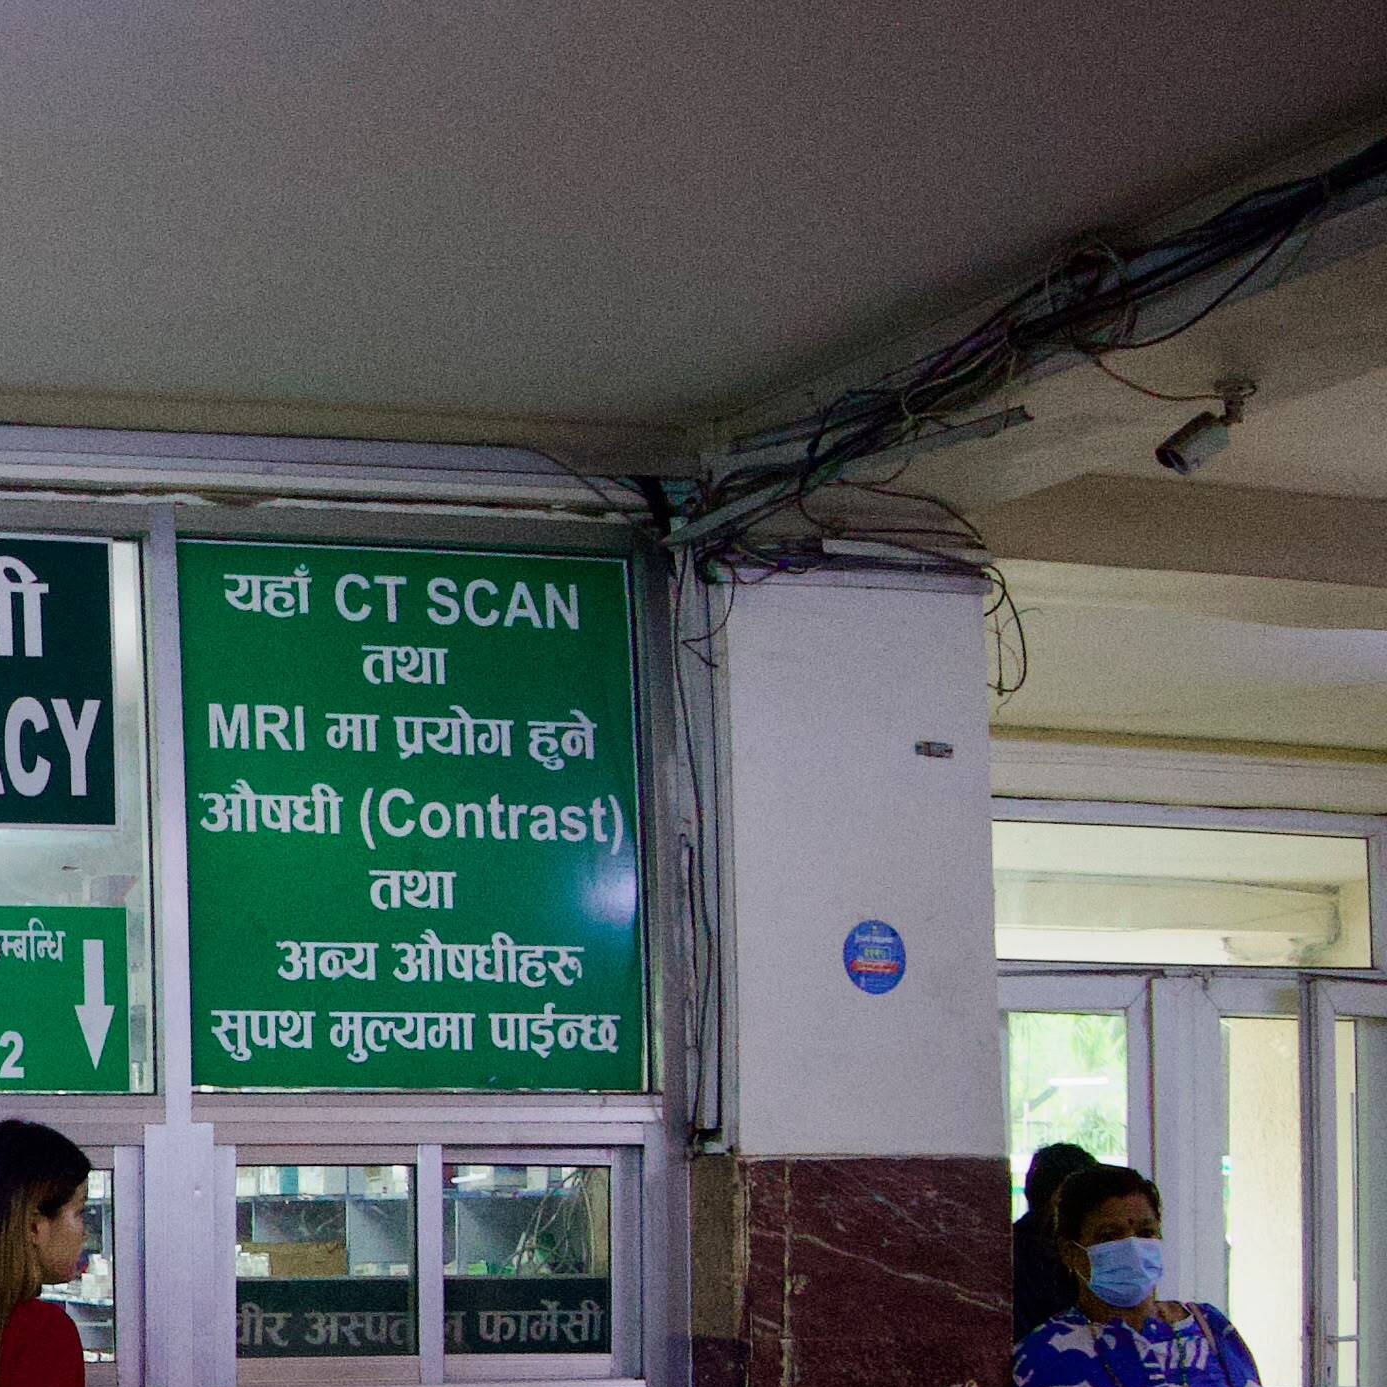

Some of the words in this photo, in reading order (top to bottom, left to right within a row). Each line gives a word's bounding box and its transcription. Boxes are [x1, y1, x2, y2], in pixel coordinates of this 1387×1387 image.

[224, 563, 312, 618] यहाँ
[334, 573, 407, 624] CT
[427, 577, 579, 630] SCAN
[362, 645, 448, 685] तथा
[208, 703, 305, 751] MRI
[326, 713, 380, 752] मा
[394, 705, 514, 759] प्रयोग
[527, 710, 597, 771] हुने
[198, 779, 344, 835] औषधी
[360, 787, 624, 856] (Contrast)
[369, 869, 456, 911] तथा
[276, 940, 379, 981] अन्य
[211, 1010, 316, 1063] सुपथ
[329, 1011, 475, 1063] मुल्यमा
[489, 1002, 621, 1058] पाईन्छ
